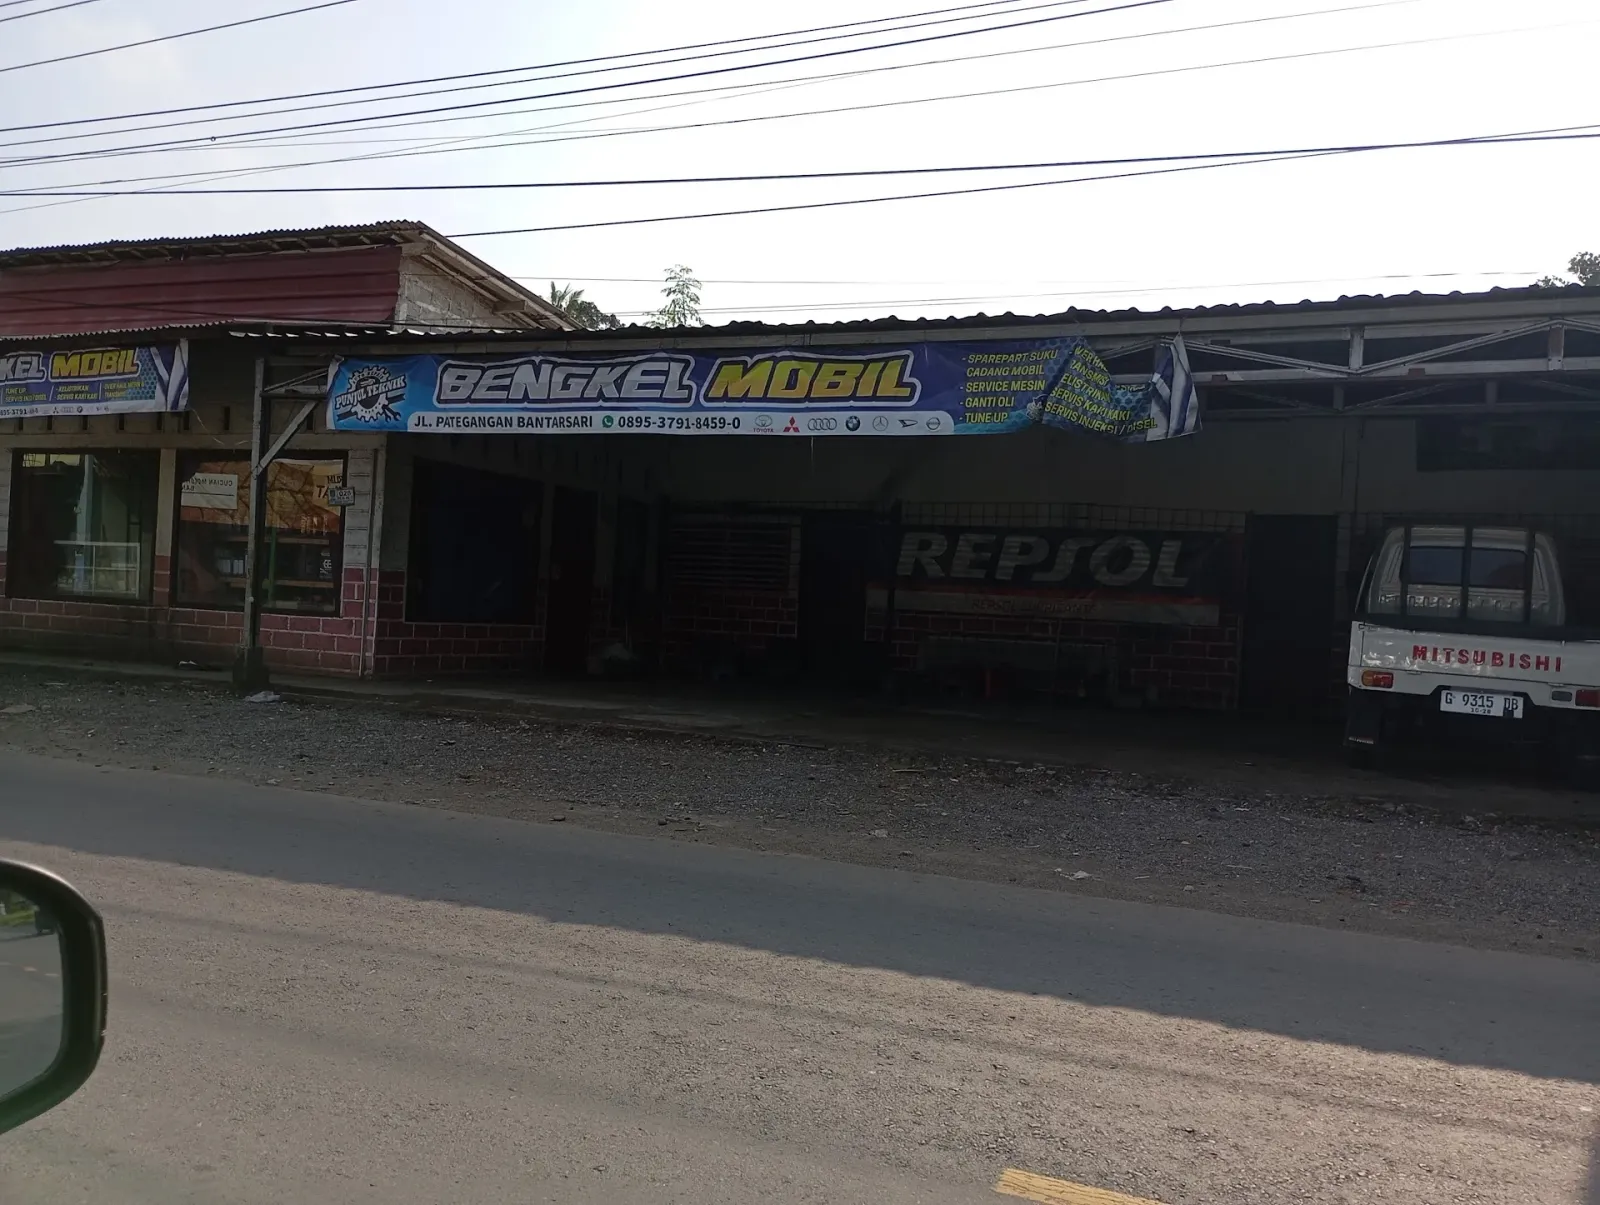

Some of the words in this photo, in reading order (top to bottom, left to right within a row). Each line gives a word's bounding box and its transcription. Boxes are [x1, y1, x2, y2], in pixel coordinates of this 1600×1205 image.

[51, 349, 138, 378] MOBIL
[967, 352, 1028, 364] SPAREPART
[1029, 349, 1059, 361] SUKU
[437, 359, 692, 401] BENGKEL
[705, 356, 914, 400] MOBIL
[966, 366, 1010, 378] CADANG
[1010, 364, 1044, 376] MOBIL
[366, 375, 406, 398] TEKNIK
[965, 381, 1009, 393] SERVICE
[1010, 380, 1046, 391] MESIN
[964, 397, 995, 408] GANTI
[997, 396, 1015, 407] OLI
[414, 415, 432, 428] JL.
[436, 415, 513, 428] PATEGANGAN
[517, 415, 593, 428] BANTARSARI
[618, 416, 741, 429] 0895-3791-8459-0
[964, 412, 990, 423] TUNE
[993, 412, 1008, 423] UP
[1044, 401, 1079, 422] SERVIS
[1078, 414, 1118, 436] INJEKSI
[896, 532, 1191, 588] REPSOL
[1412, 644, 1562, 672] MITSUBISHI
[1445, 692, 1453, 704] G
[1462, 694, 1494, 708] 9315
[1504, 697, 1519, 711] DB
